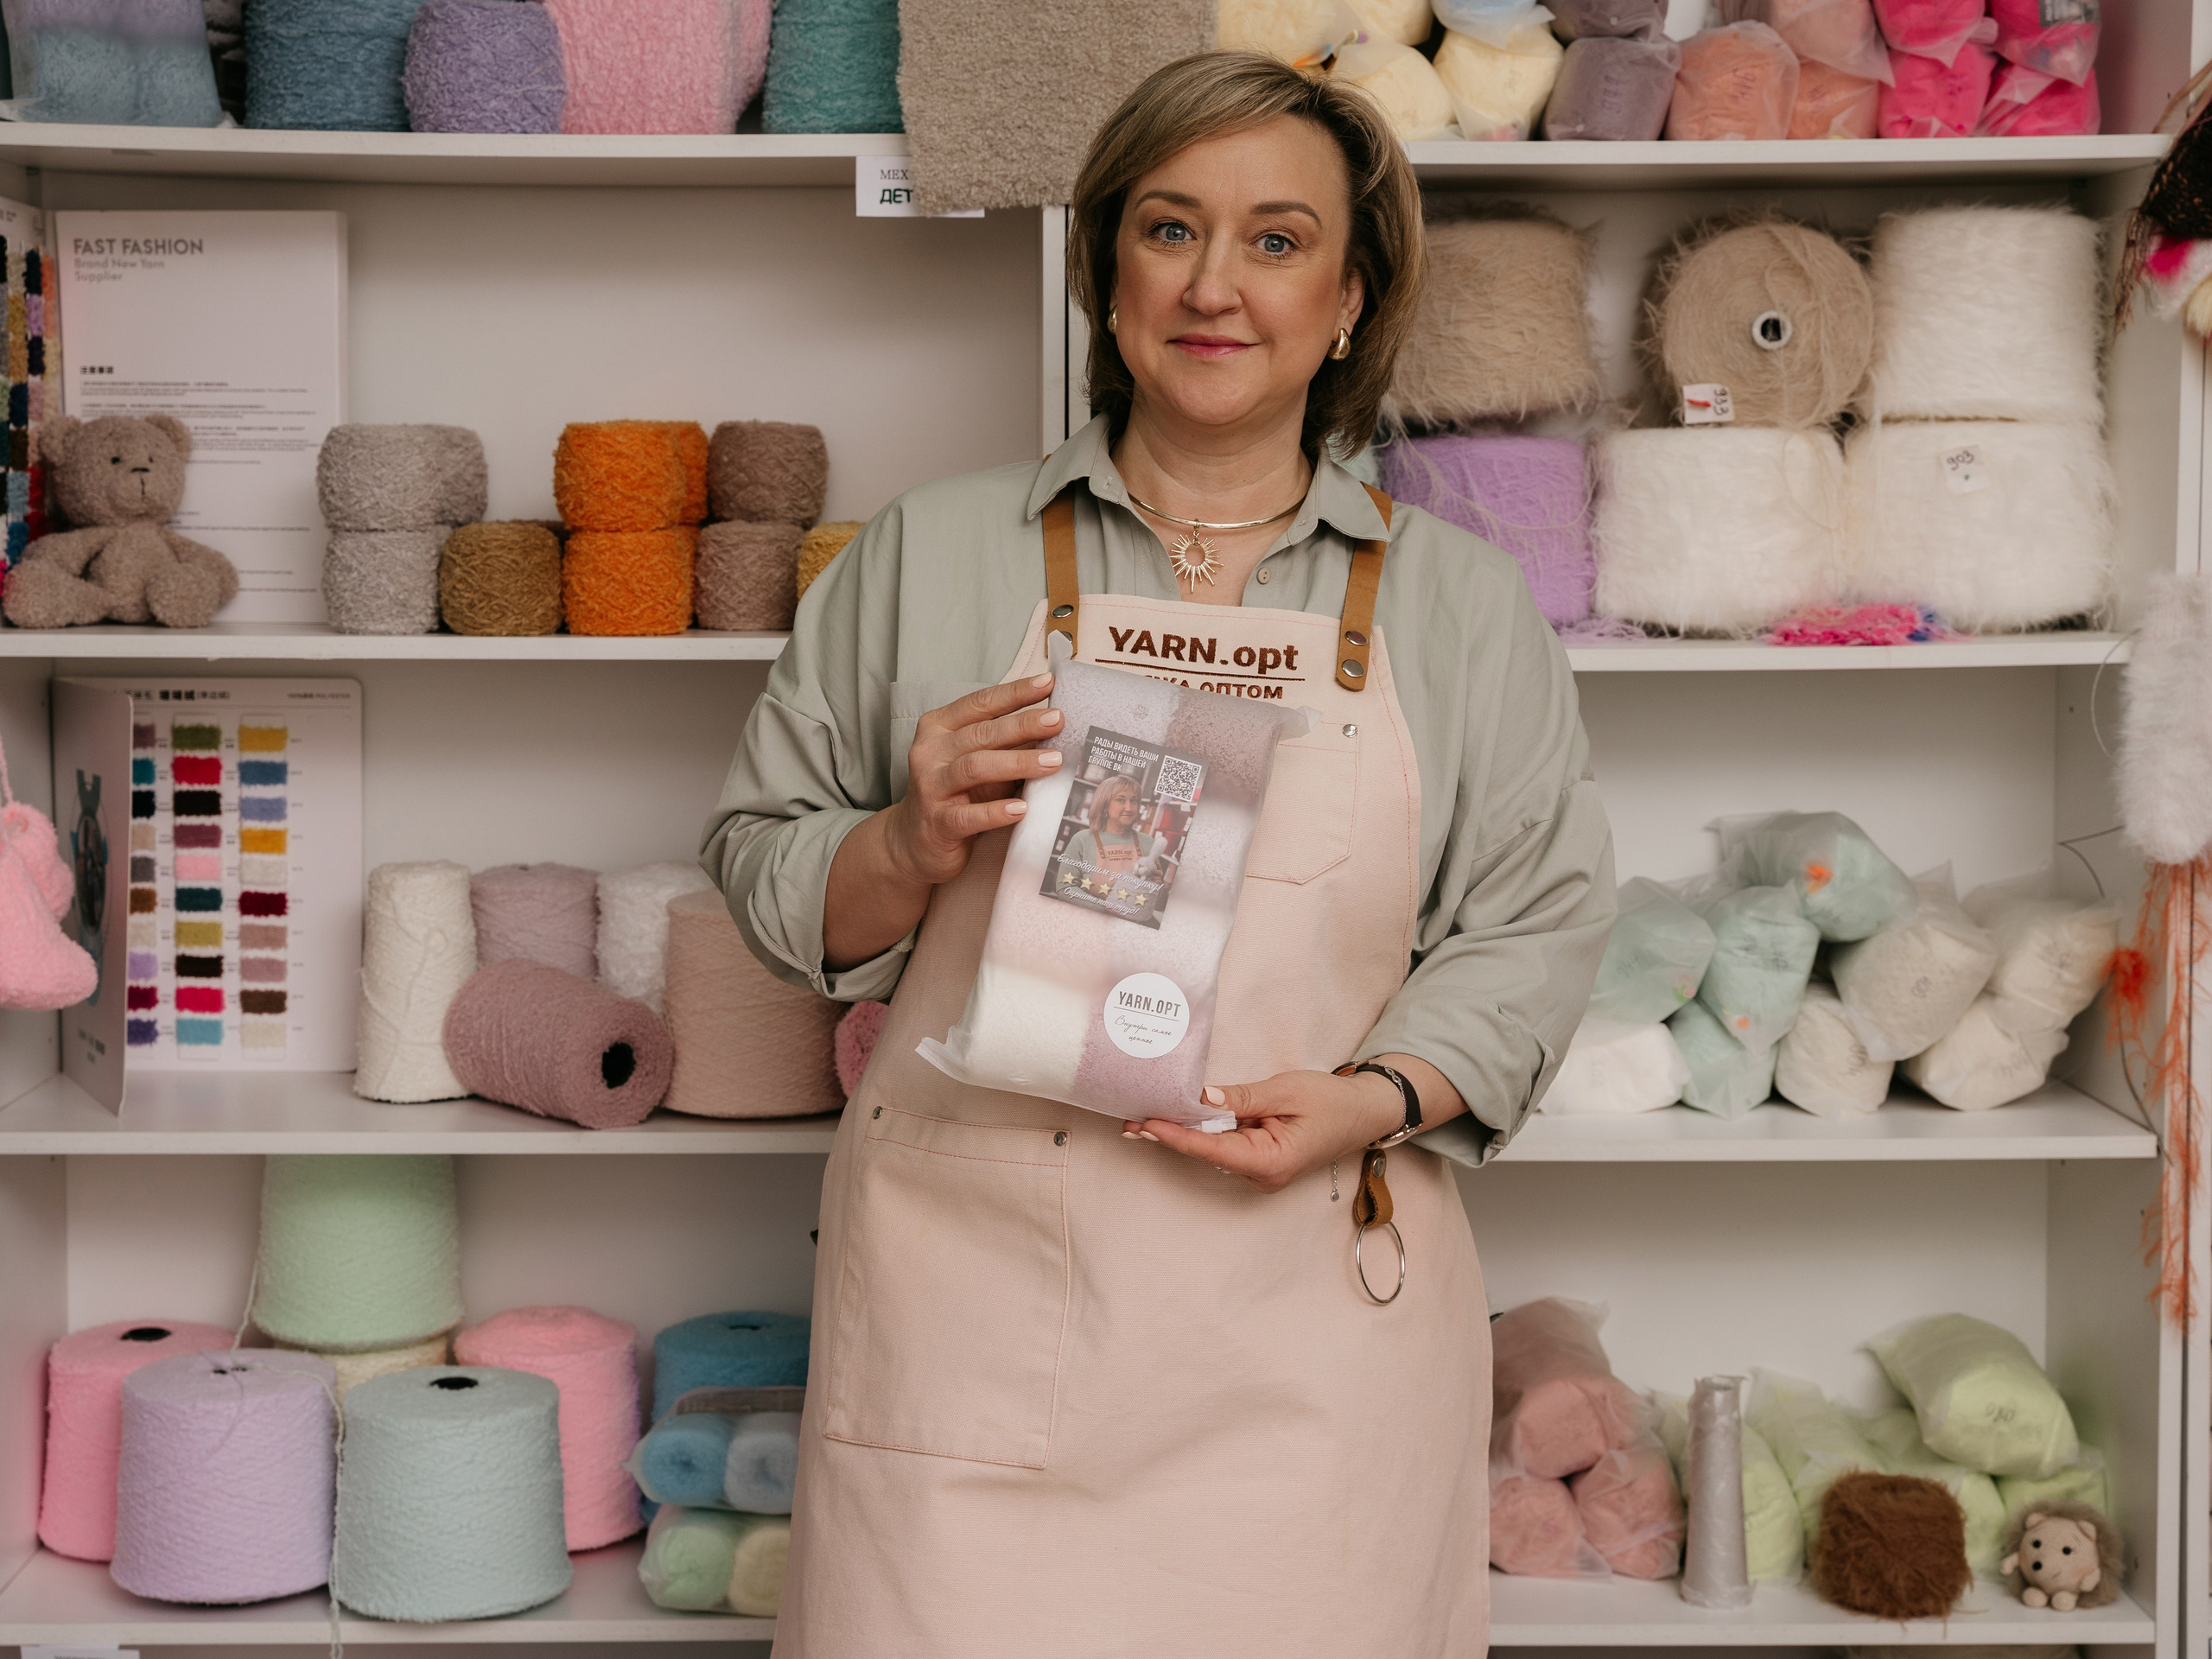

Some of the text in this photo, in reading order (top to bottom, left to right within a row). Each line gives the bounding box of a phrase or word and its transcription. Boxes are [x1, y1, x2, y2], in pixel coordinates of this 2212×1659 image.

[73, 238, 204, 255] FAST FASHION
[74, 258, 165, 269] Brand New Yarn
[74, 271, 123, 283] Supplier
[1946, 449, 1974, 471] 903
[1109, 626, 1299, 675] YARN.opt
[1091, 746, 1147, 770] РАБОТЫ В НАШЕЙ
[1094, 736, 1159, 762] РАДЫ ВИДЕТЬ ВАШИ
[1089, 755, 1123, 772] ГРУППЕ ВК
[1057, 853, 1164, 893] Благодарим за покупку!
[1064, 887, 1140, 916] Оцените наш труд!
[1119, 991, 1181, 1017] YARN.OPT
[1115, 1014, 1148, 1034] Внутри
[1128, 1036, 1154, 1045] ценное
